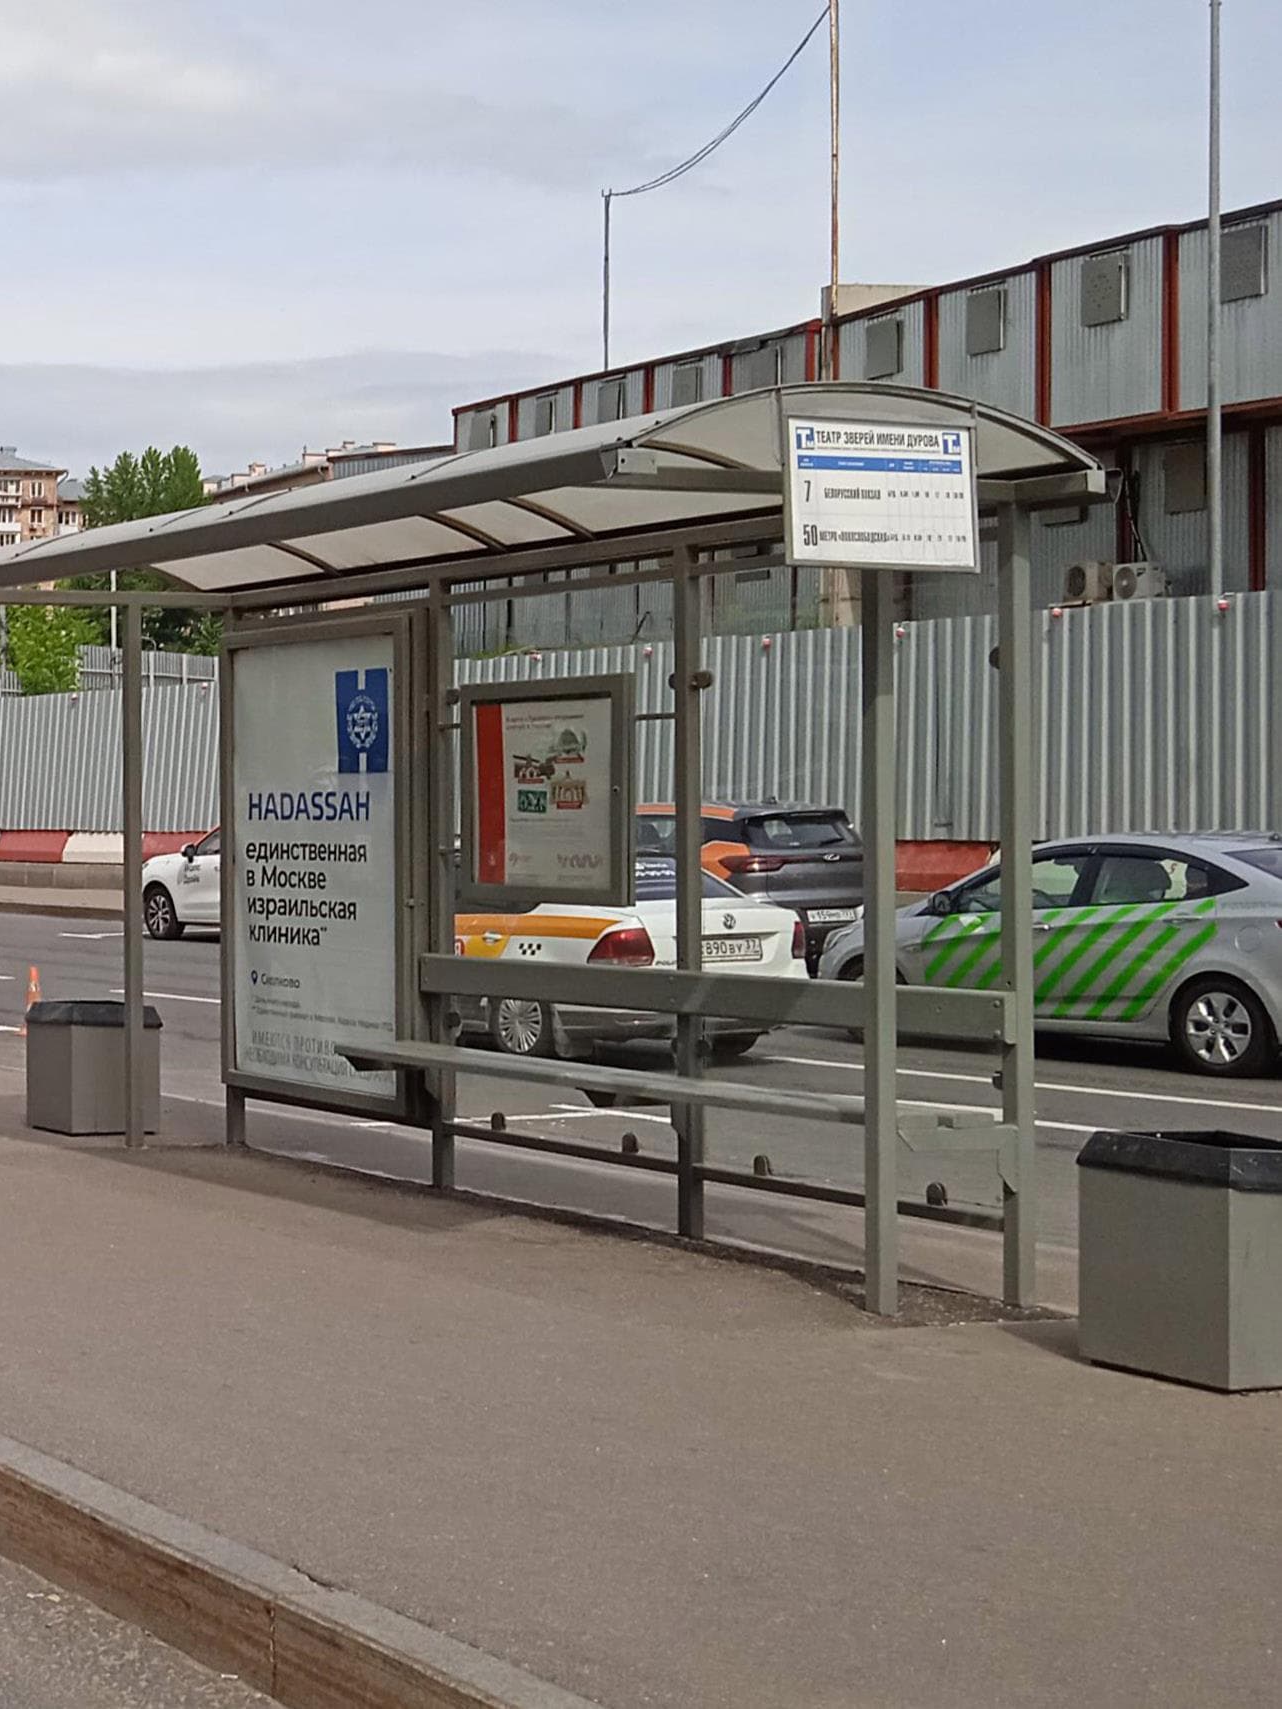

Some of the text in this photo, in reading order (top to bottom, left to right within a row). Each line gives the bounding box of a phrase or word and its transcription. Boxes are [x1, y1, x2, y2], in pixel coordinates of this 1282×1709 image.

[816, 430, 940, 448] ТЕАТР ЗВЕРЕЙ ИМЕНИ ДУРОВА
[804, 480, 811, 502] 7
[803, 524, 818, 546] 50
[248, 791, 370, 821] HADASSAH
[246, 841, 367, 863] единственная
[246, 865, 326, 889] в Москве
[247, 896, 357, 920] израильская
